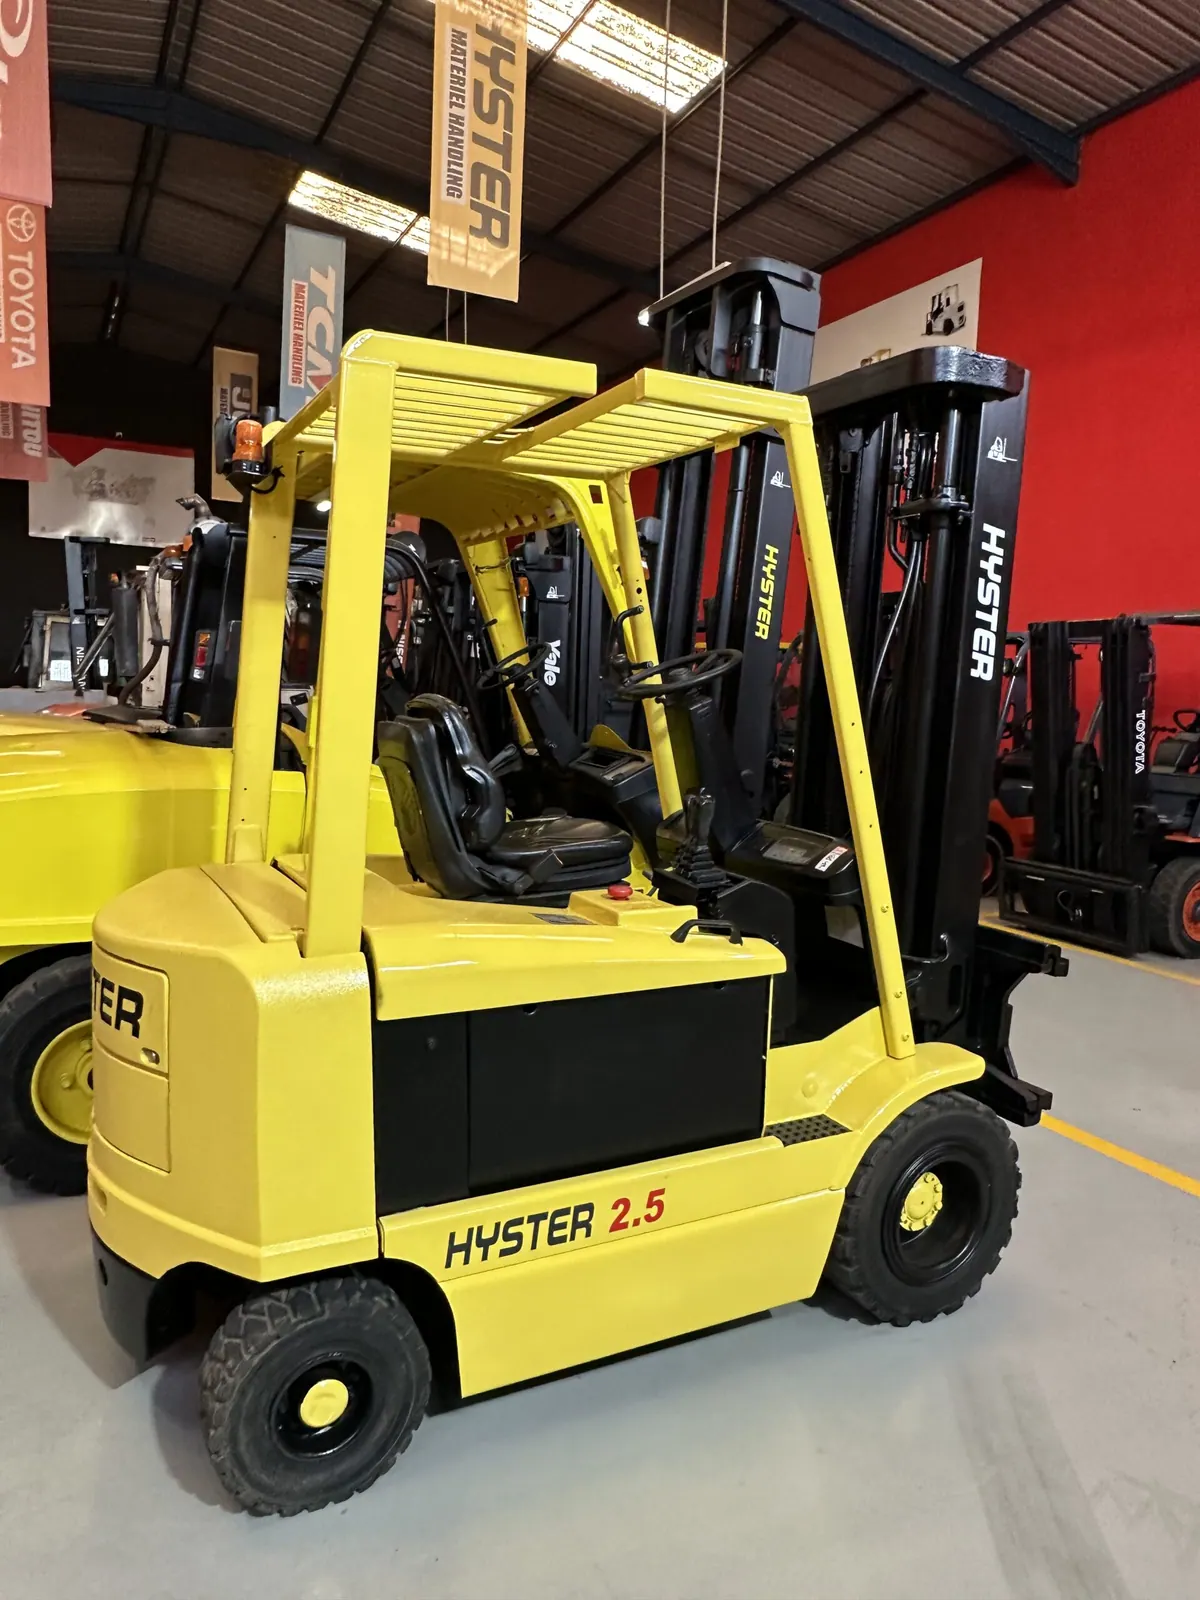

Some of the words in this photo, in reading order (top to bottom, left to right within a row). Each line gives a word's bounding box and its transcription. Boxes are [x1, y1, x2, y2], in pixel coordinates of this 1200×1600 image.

[448, 27, 468, 112] MATERIEL
[446, 115, 465, 200] HANDLING
[7, 251, 37, 369] TOYOTA
[292, 282, 306, 331] MATERIEL
[290, 332, 305, 385] HANDLING
[755, 543, 779, 640] HYSTER
[969, 522, 1006, 682] HYSTER
[543, 639, 561, 686] Yale
[1134, 709, 1146, 775] TOYOTA
[444, 1202, 595, 1269] HYSTER
[608, 1187, 666, 1233] 2.5
